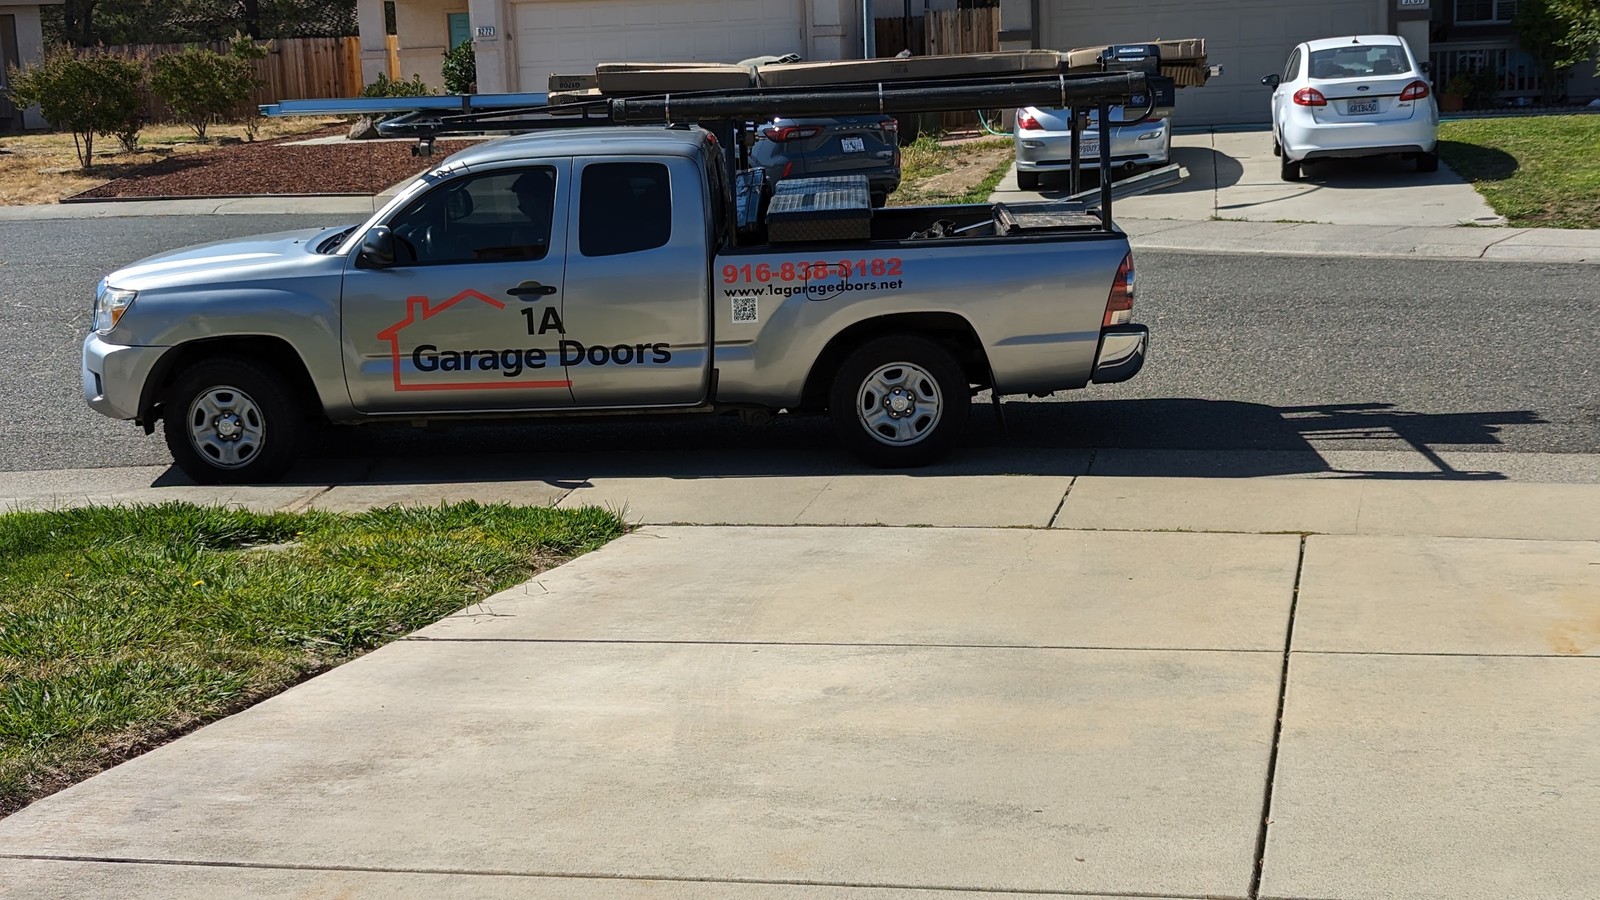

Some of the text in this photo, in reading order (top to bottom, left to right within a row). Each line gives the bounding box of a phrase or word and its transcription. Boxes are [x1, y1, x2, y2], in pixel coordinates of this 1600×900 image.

[477, 28, 492, 36] 9272
[722, 257, 903, 284] 916-838-8182
[724, 279, 903, 298] www.1agaragedoors.net
[520, 306, 566, 335] 1A
[412, 340, 672, 377] Garage Doors
